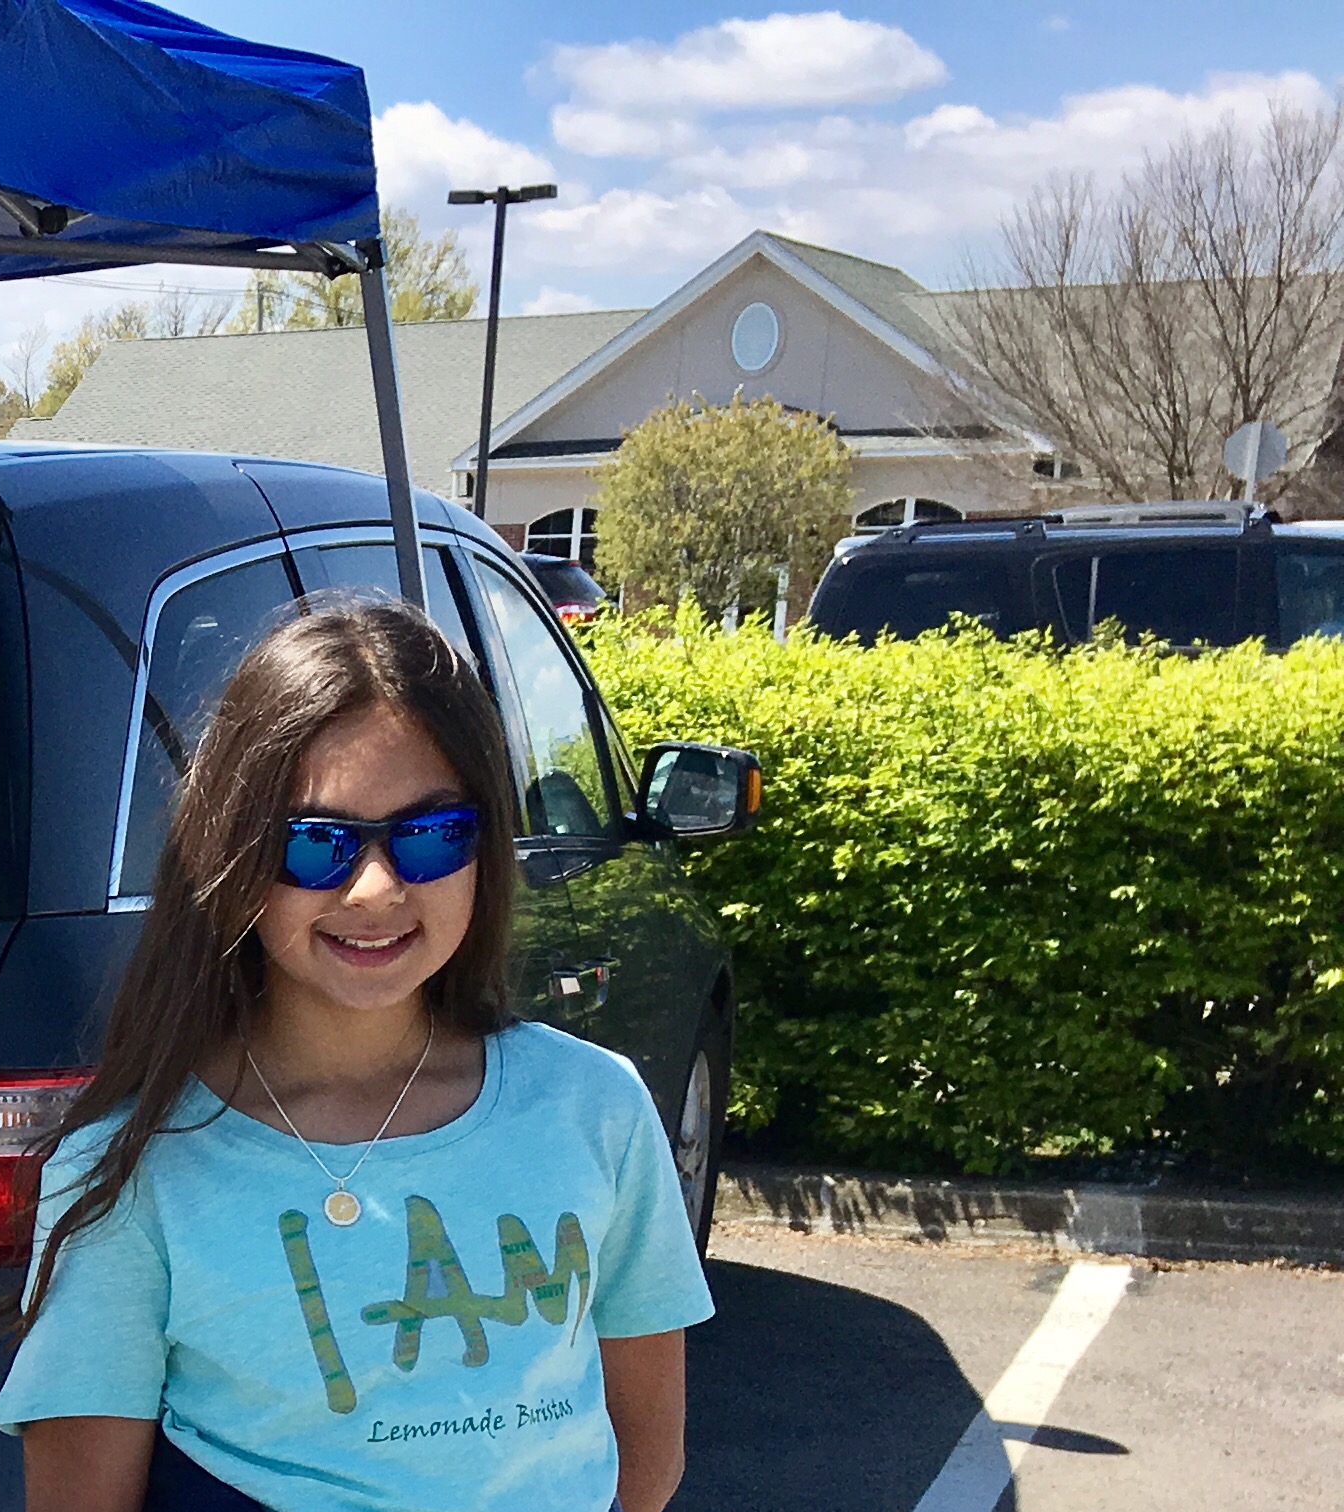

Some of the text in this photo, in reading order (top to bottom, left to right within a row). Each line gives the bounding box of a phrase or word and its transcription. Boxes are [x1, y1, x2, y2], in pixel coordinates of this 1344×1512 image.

[278, 1195, 590, 1414] I AM
[367, 1398, 574, 1443] Lemonade Baristas
